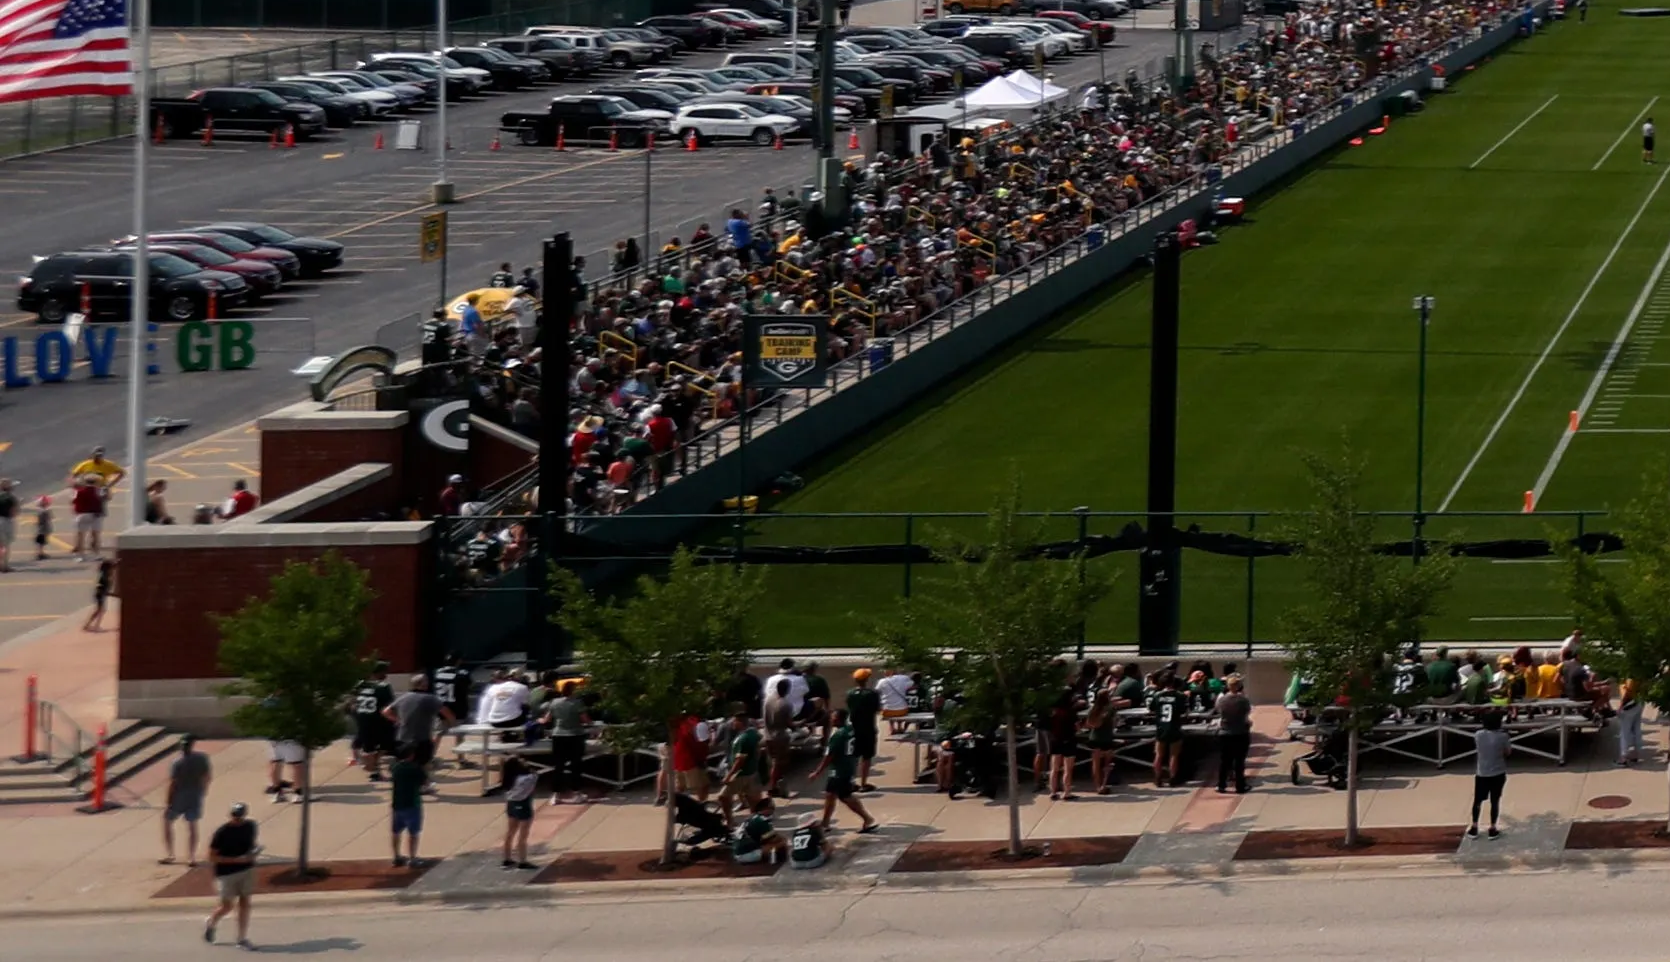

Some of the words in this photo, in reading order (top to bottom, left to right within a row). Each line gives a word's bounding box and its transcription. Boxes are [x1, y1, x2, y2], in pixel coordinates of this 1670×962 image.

[177, 321, 256, 372] GB
[767, 338, 811, 347] TRAINING
[775, 347, 802, 356] CAMP
[356, 696, 377, 713] 23
[1161, 703, 1172, 722] 9
[793, 835, 811, 850] 87
